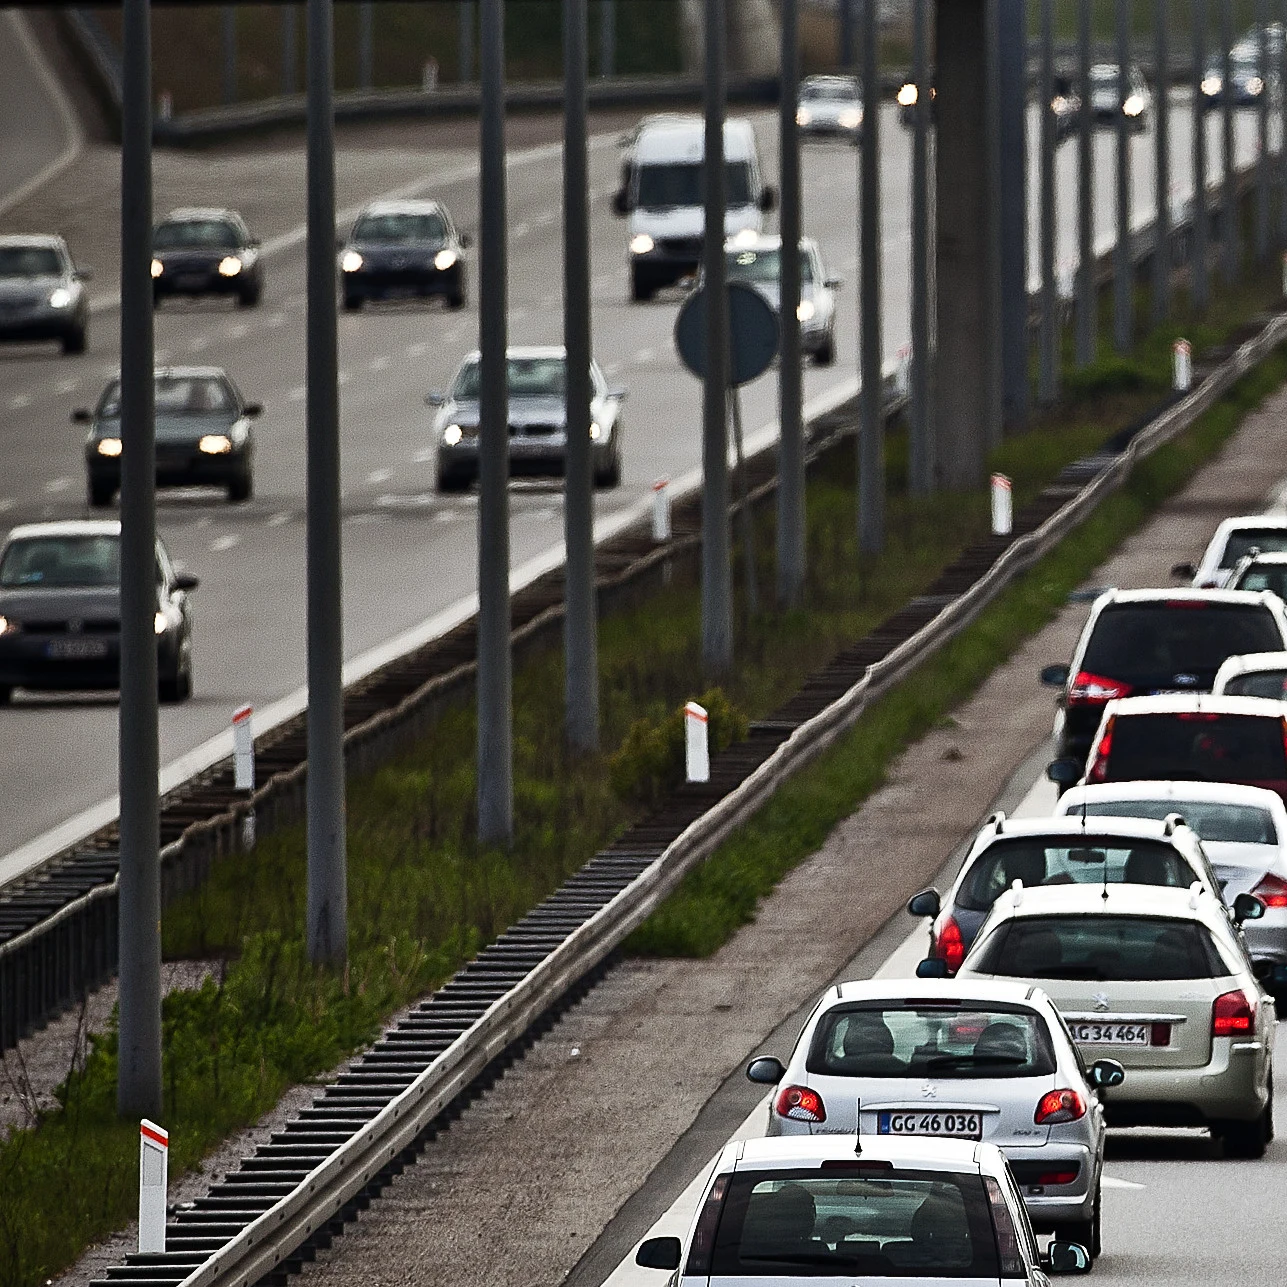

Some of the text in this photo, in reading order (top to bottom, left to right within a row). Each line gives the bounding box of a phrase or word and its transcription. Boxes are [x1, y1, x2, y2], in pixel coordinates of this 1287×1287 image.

[1093, 1026, 1112, 1041] 34
[1116, 1026, 1146, 1041] 464
[891, 1115, 977, 1132] GG 46 036
